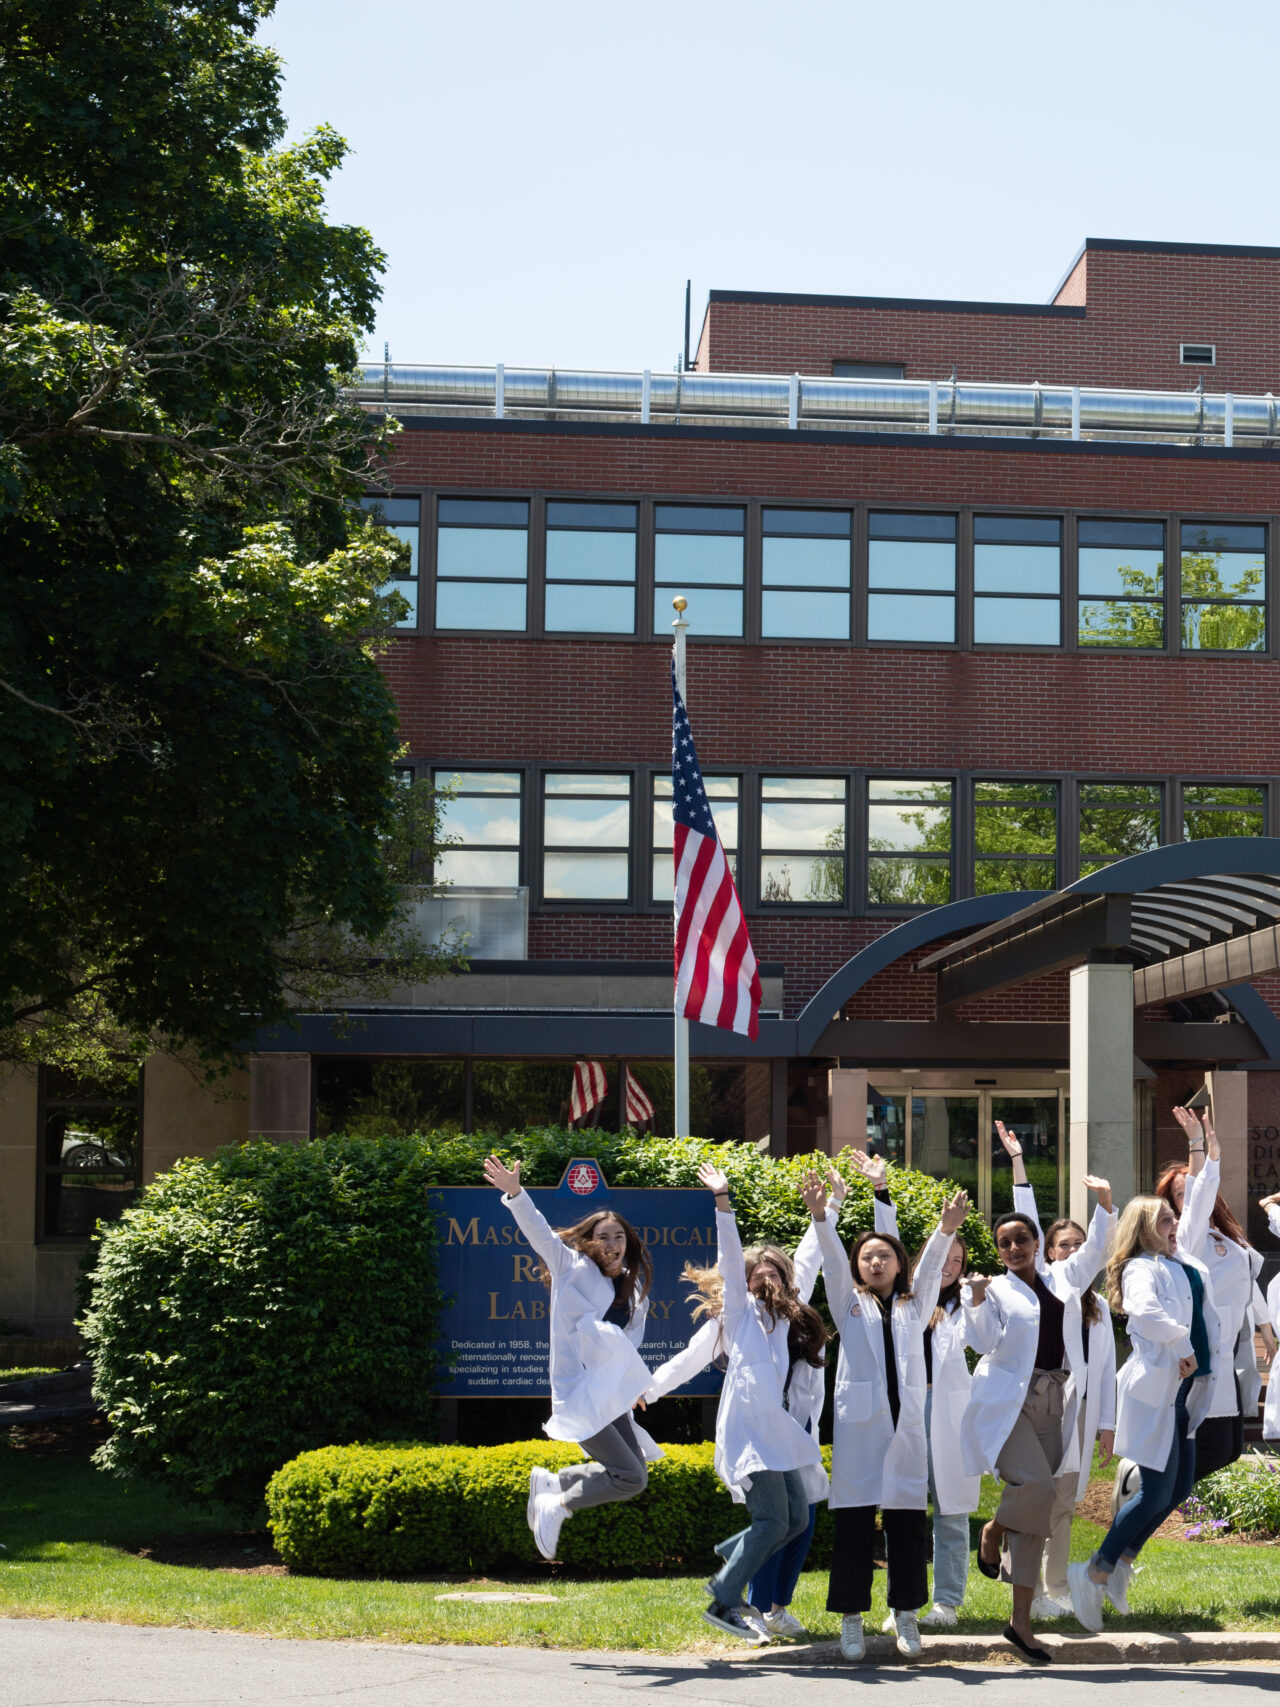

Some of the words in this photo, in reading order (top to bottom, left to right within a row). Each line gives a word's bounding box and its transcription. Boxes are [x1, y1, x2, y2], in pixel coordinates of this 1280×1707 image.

[634, 1226, 718, 1246] DICAL
[451, 1340, 495, 1349] Dedicated
[498, 1340, 506, 1349] in
[509, 1340, 532, 1350] 1958,
[536, 1341, 549, 1349] the
[640, 1341, 667, 1349] search
[669, 1340, 685, 1349] Lab
[457, 1353, 516, 1362] nternationally
[449, 1365, 498, 1374] specializing
[501, 1365, 509, 1373] in
[512, 1365, 544, 1373] studies
[468, 1377, 499, 1385] sudden
[502, 1377, 533, 1385] cardiac
[536, 1377, 551, 1385] dea
